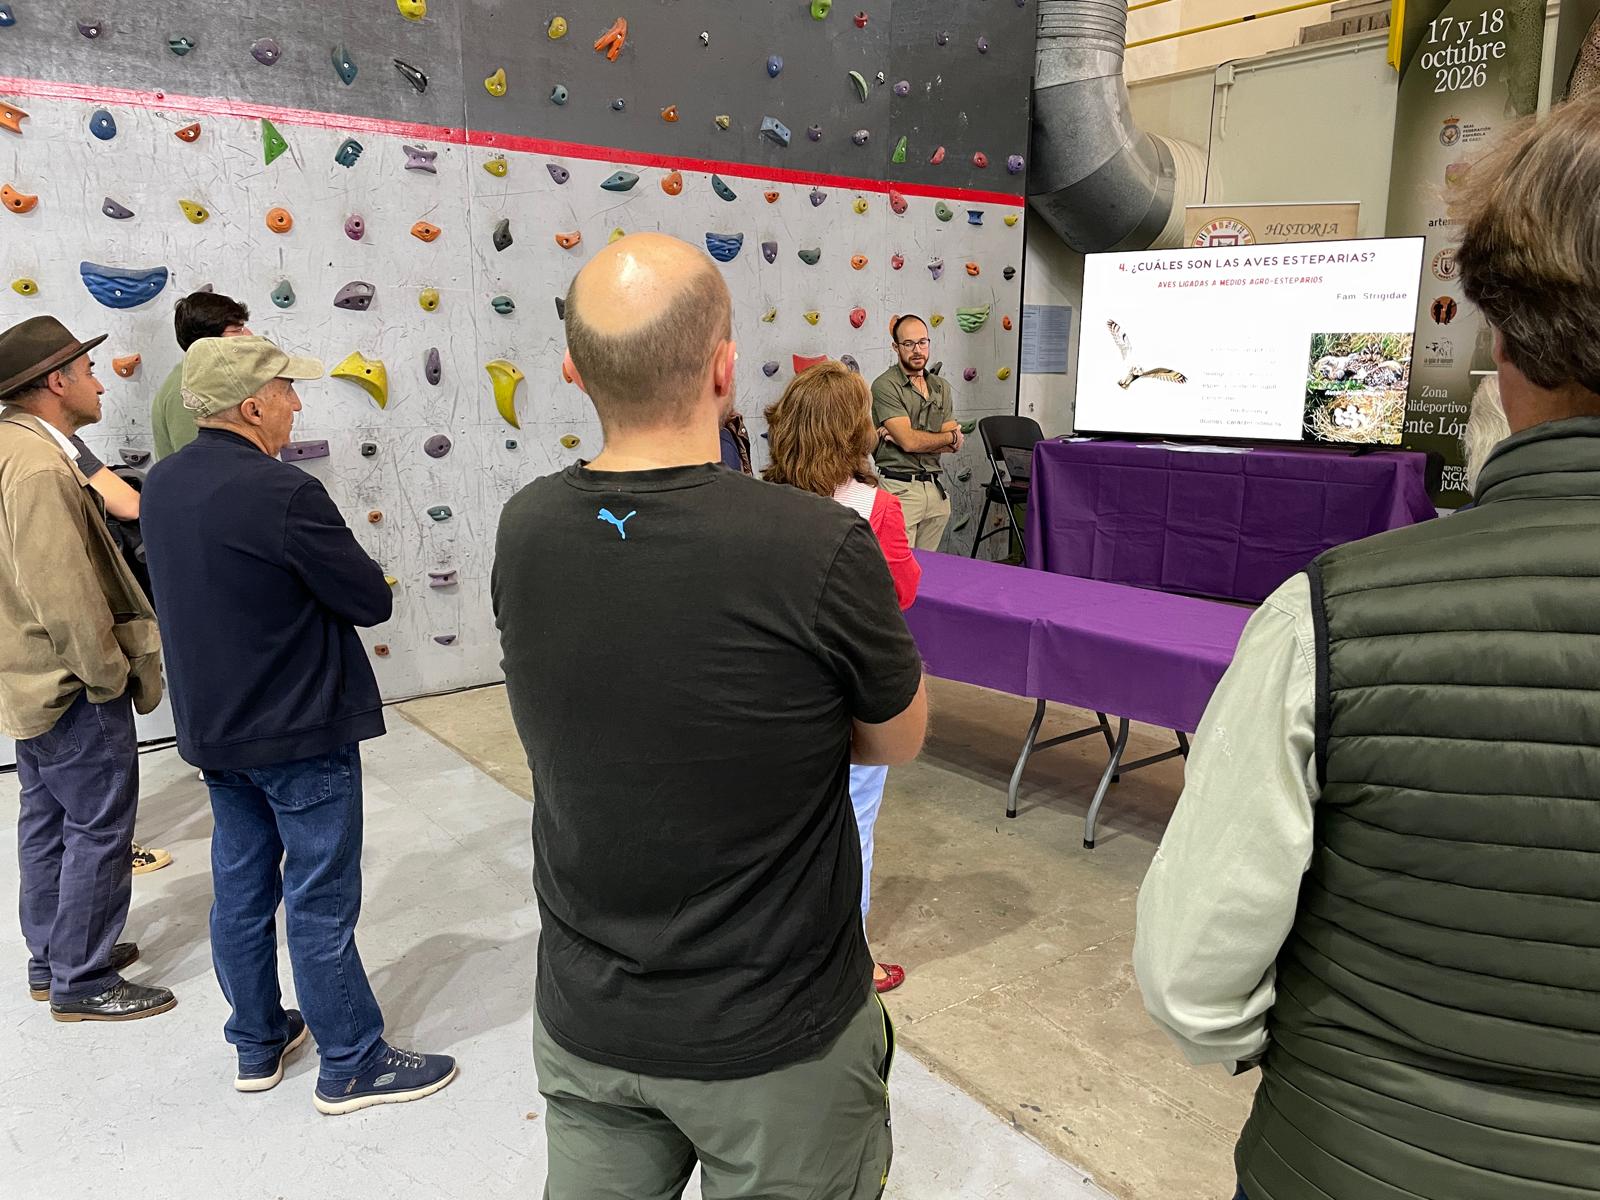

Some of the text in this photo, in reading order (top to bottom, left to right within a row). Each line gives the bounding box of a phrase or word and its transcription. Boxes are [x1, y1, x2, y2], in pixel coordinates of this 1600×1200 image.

[1427, 8, 1504, 45] 17 y 18
[1420, 37, 1506, 70] octubre
[1434, 62, 1487, 93] 2026
[1264, 222, 1339, 237] HISTORIA
[1118, 252, 1376, 274] 4. ¿CUÁLES SON LAS AVES ESTEPARIAS?
[1158, 276, 1324, 288] AVES LIGADAS A MEDIOS AGRO-ESTEPARIOS
[1421, 385, 1448, 398] Zona
[1406, 399, 1468, 415] lideportivo
[1437, 416, 1468, 441] Lóp
[1439, 480, 1470, 492] JUAN
